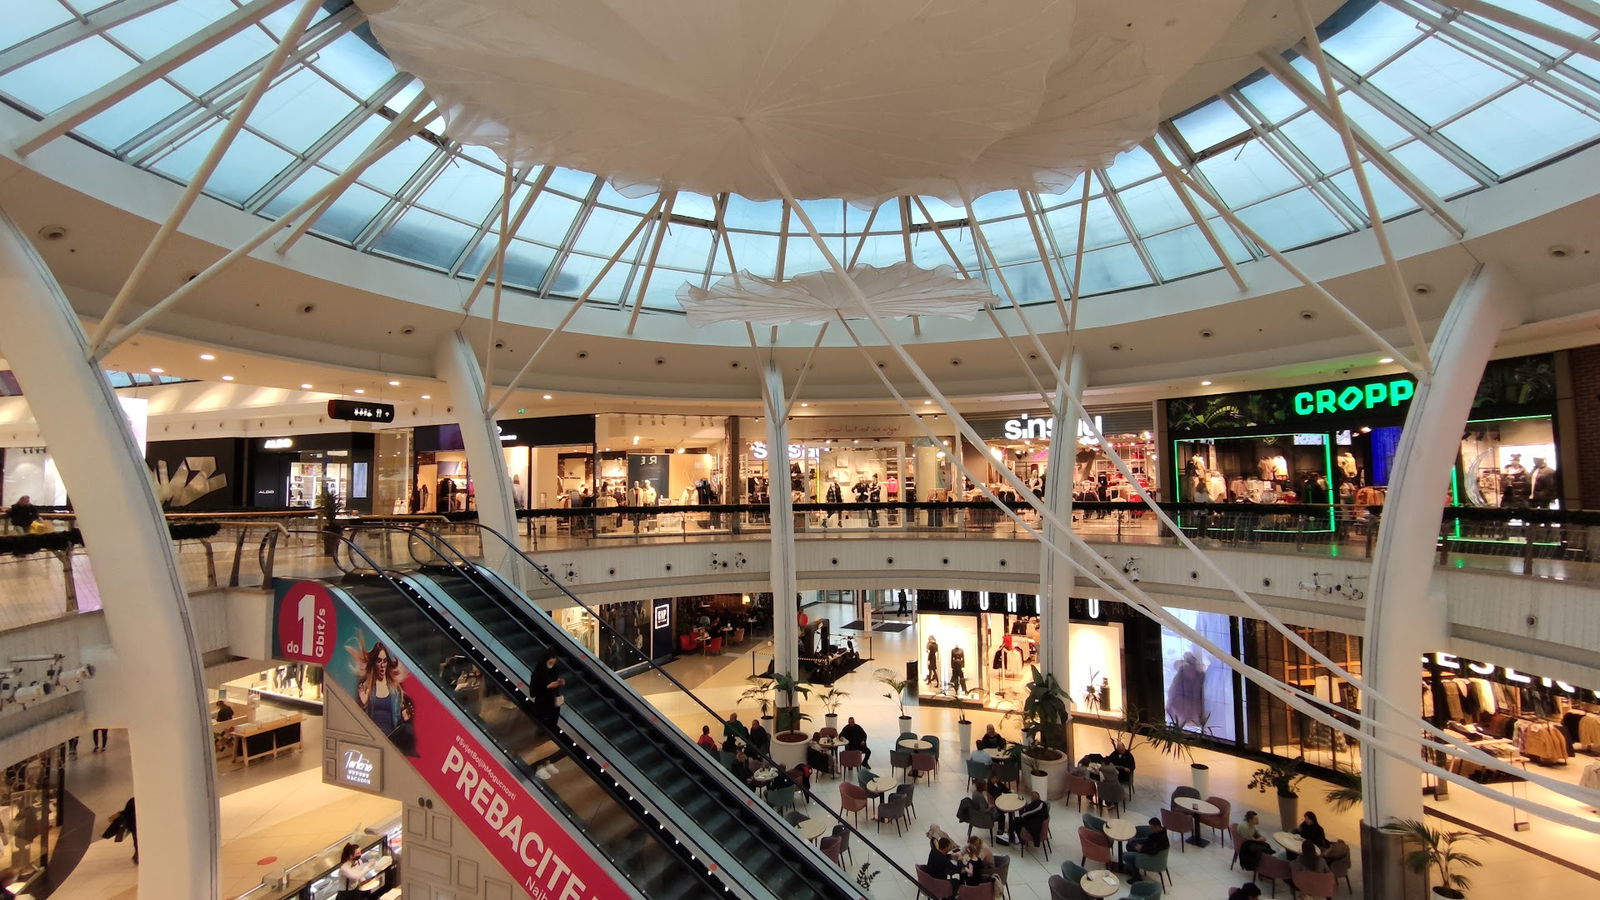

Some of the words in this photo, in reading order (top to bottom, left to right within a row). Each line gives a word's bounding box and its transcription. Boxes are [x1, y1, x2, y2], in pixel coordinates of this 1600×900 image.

[1294, 379, 1414, 416] CROPP
[1004, 413, 1103, 445] siny
[286, 640, 299, 654] do
[297, 594, 315, 656] 1
[315, 608, 326, 658] Gbit/s
[441, 745, 586, 900] PREBACITE
